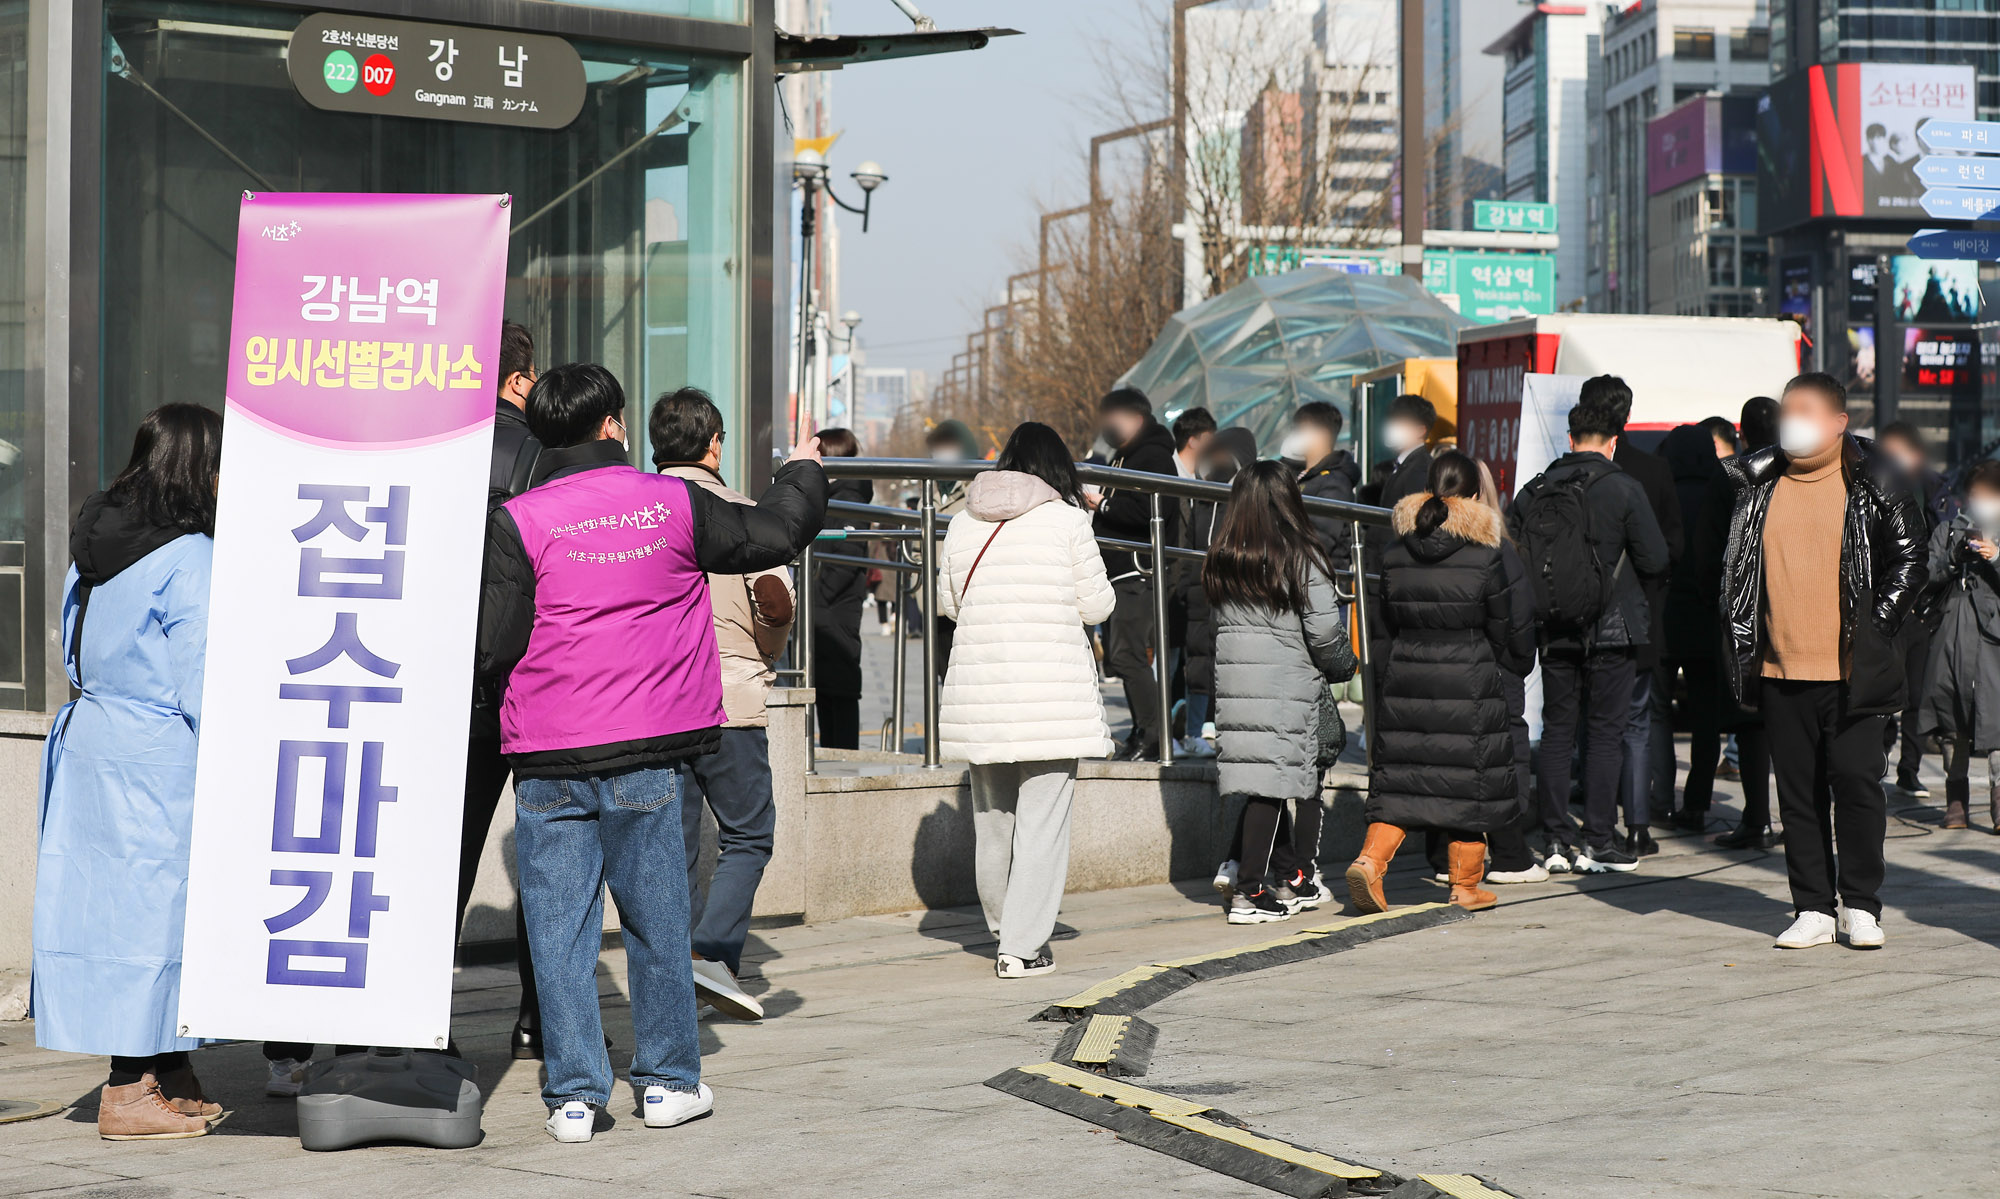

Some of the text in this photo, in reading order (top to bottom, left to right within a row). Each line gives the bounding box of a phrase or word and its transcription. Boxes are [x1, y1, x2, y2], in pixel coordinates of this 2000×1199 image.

[326, 62, 394, 84] 222 D07
[415, 89, 539, 112] Gangnam 江南 カンナム
[1868, 82, 1968, 108] 소년심판
[1489, 206, 1545, 227] 강남역
[262, 222, 291, 241] 서초
[1953, 239, 1989, 254] 베이징
[1471, 265, 1534, 288] 역삼역
[300, 275, 439, 326] 강남역
[245, 335, 483, 392] 임시선별검사소
[619, 506, 659, 530] 서초
[566, 536, 668, 564] 서초구공무원자원봉사단
[263, 483, 411, 989] 접수마감
